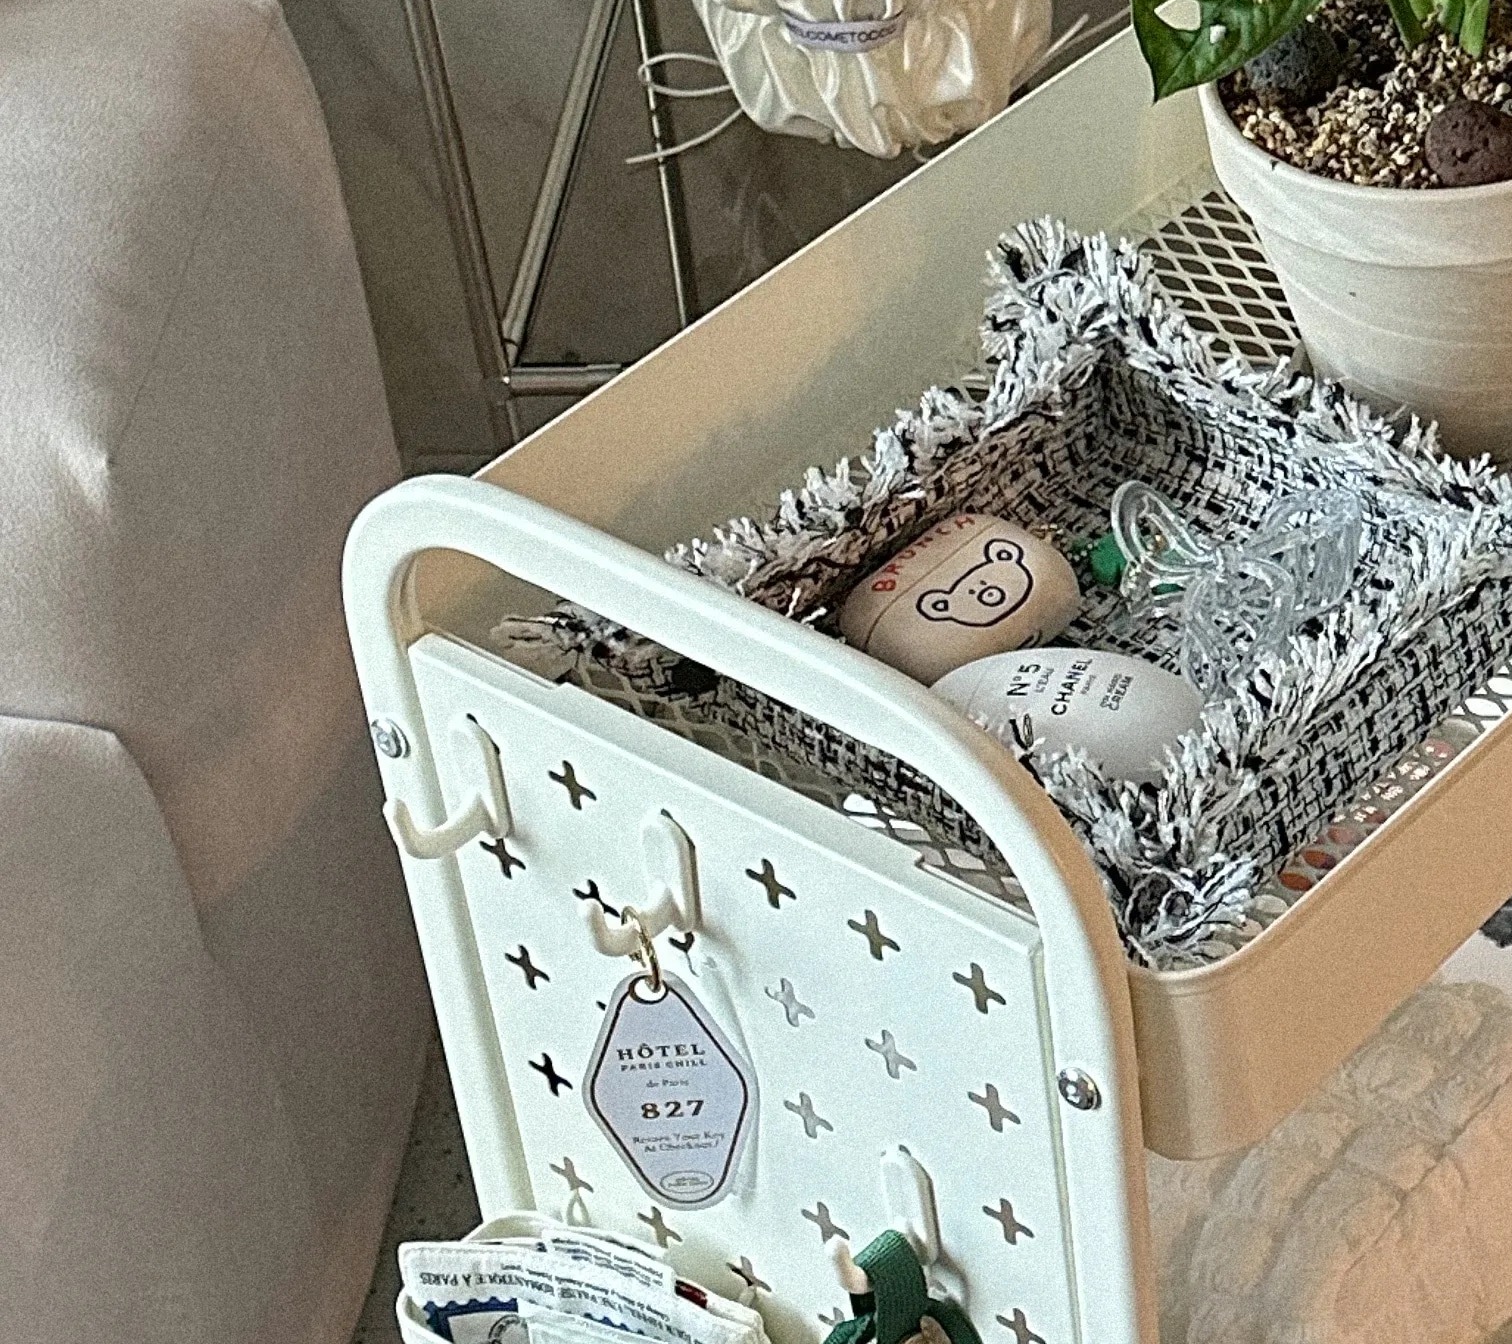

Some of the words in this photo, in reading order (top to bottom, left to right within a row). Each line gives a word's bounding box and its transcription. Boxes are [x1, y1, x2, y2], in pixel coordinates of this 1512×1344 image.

[1051, 658, 1093, 715] CHANEL
[617, 1043, 706, 1061] HÔTEL
[620, 1061, 661, 1072] PARIS
[665, 1058, 708, 1069] CHILL
[641, 1099, 704, 1119] 827
[419, 1271, 458, 1285] PARIS
